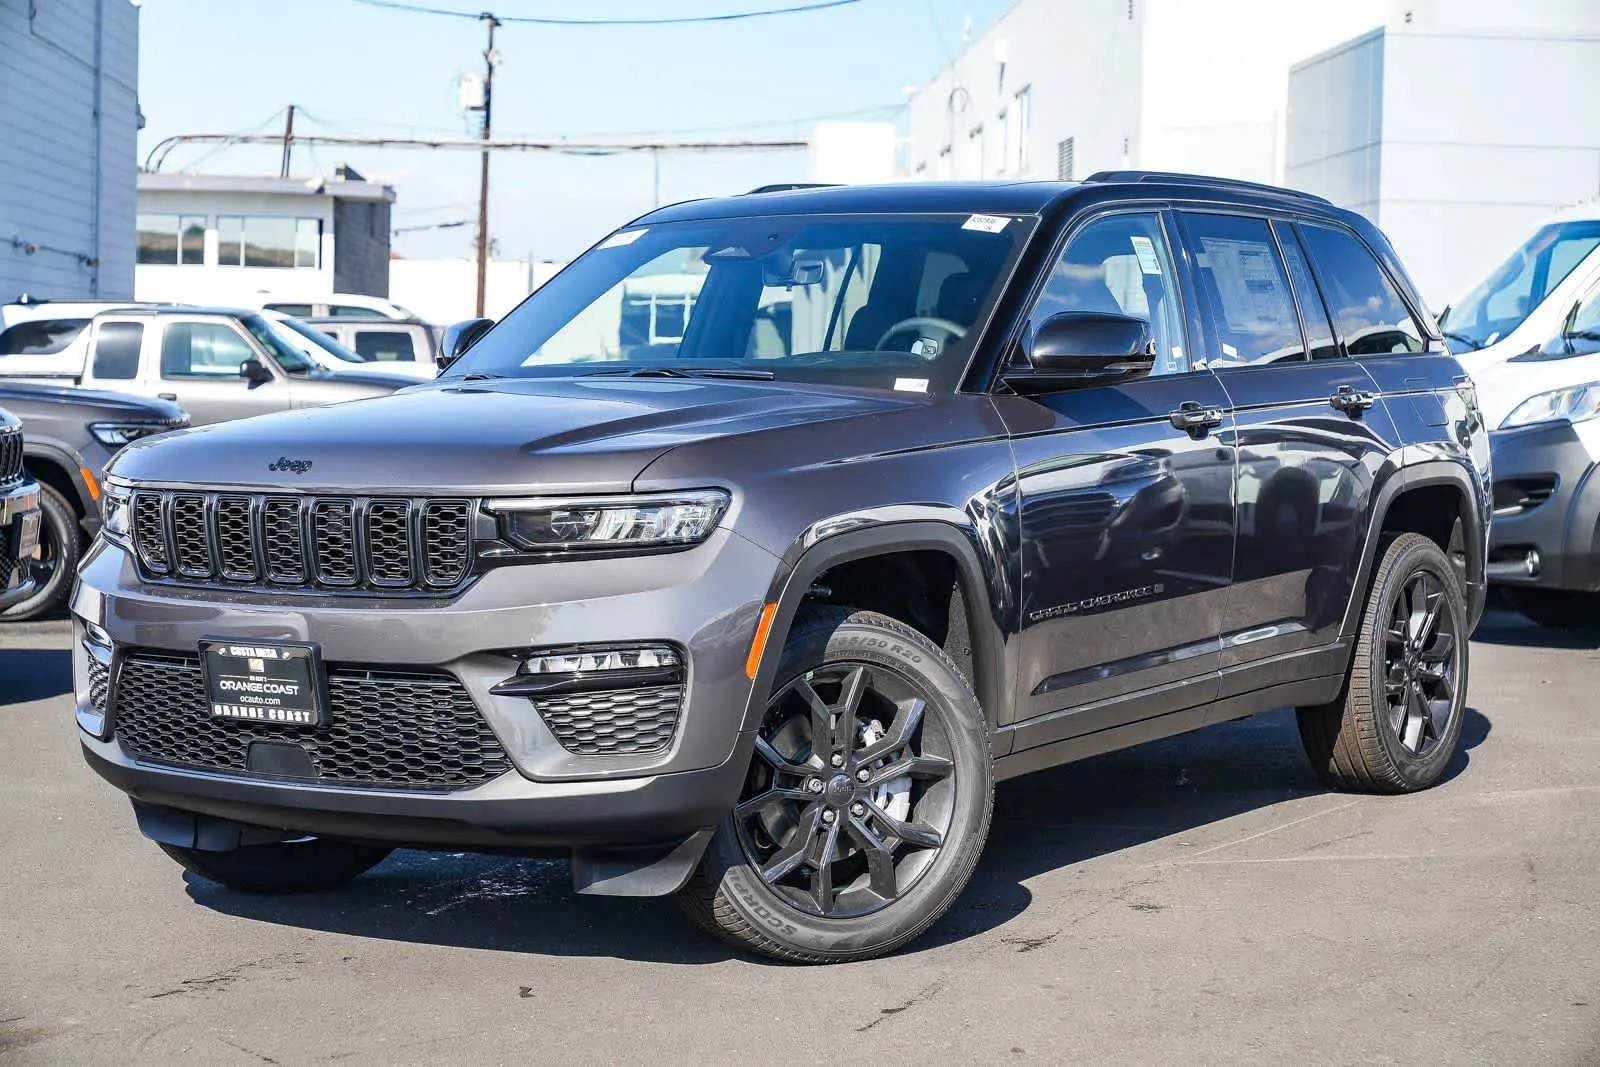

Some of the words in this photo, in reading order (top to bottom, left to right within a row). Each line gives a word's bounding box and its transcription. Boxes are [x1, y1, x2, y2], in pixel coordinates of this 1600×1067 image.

[219, 680, 264, 693] ORANGE
[263, 683, 300, 696] COAST
[239, 695, 281, 706] ocauto.com
[214, 704, 264, 719] ORANGE
[268, 708, 310, 722] COAST
